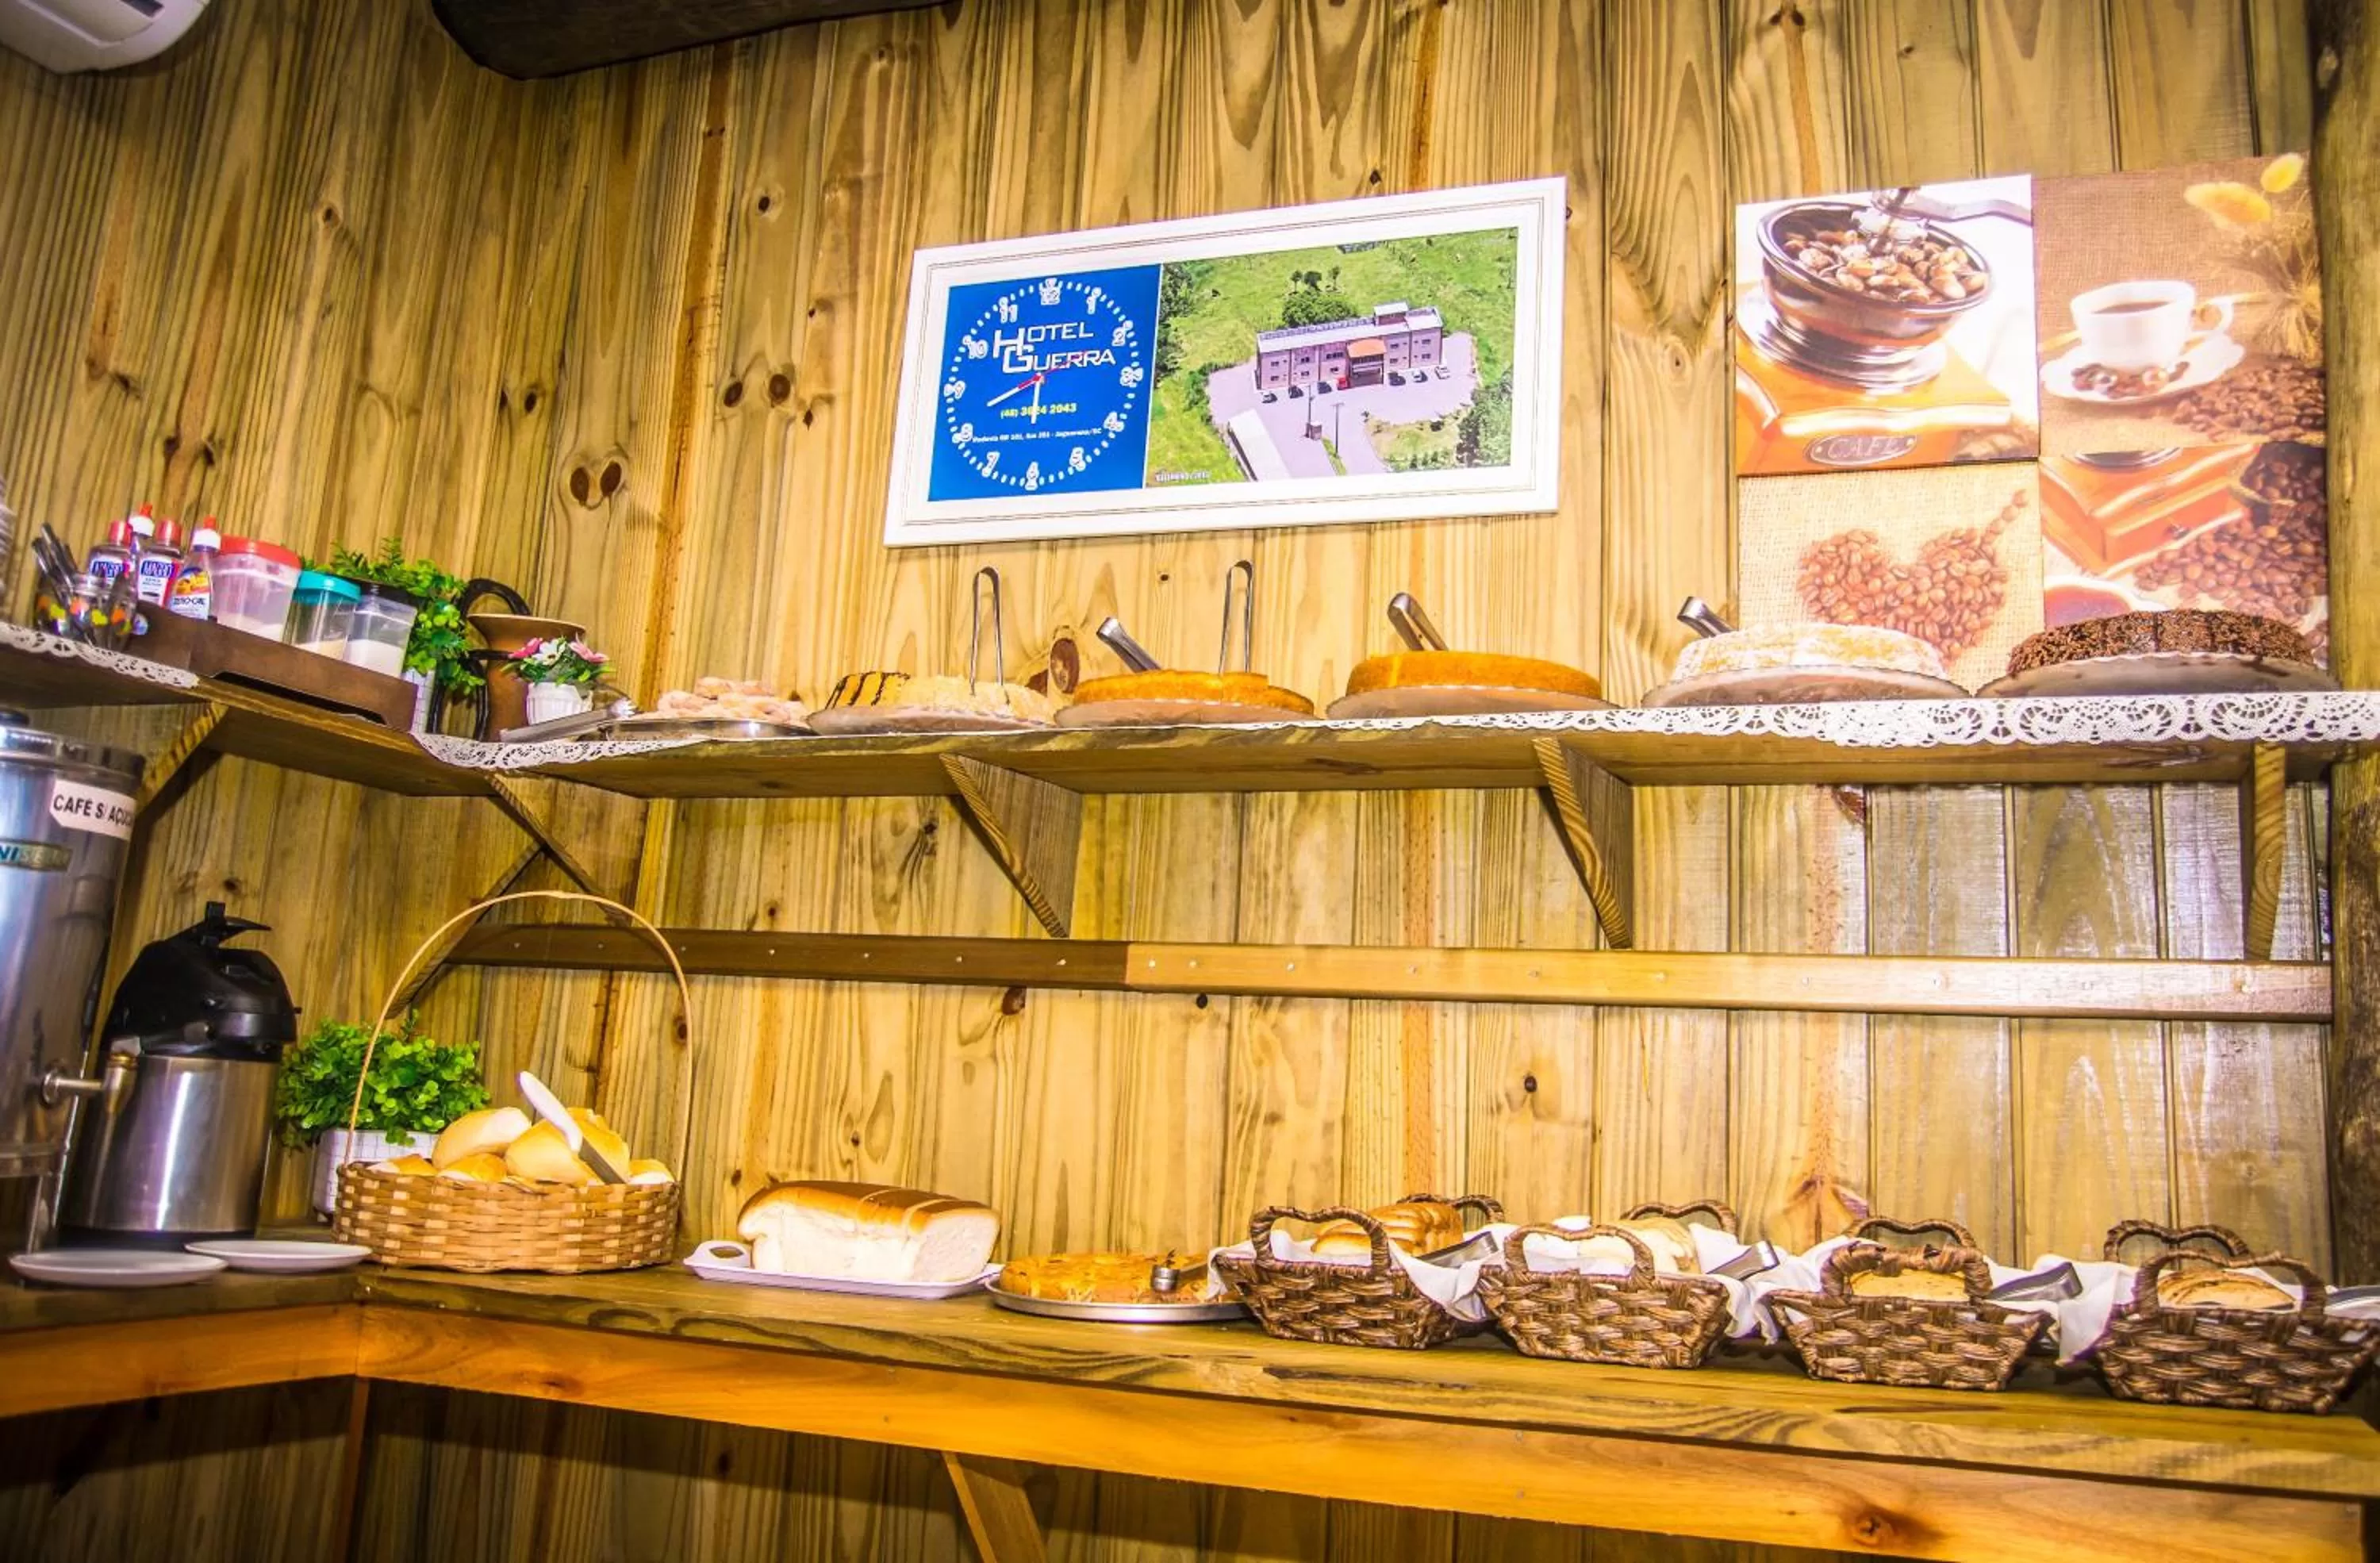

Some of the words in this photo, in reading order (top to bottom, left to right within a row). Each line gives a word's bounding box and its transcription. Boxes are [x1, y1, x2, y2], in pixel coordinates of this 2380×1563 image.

[992, 321, 1094, 359] HOTEL
[1002, 344, 1116, 374] GUERRA
[1050, 402, 1077, 415] 2043
